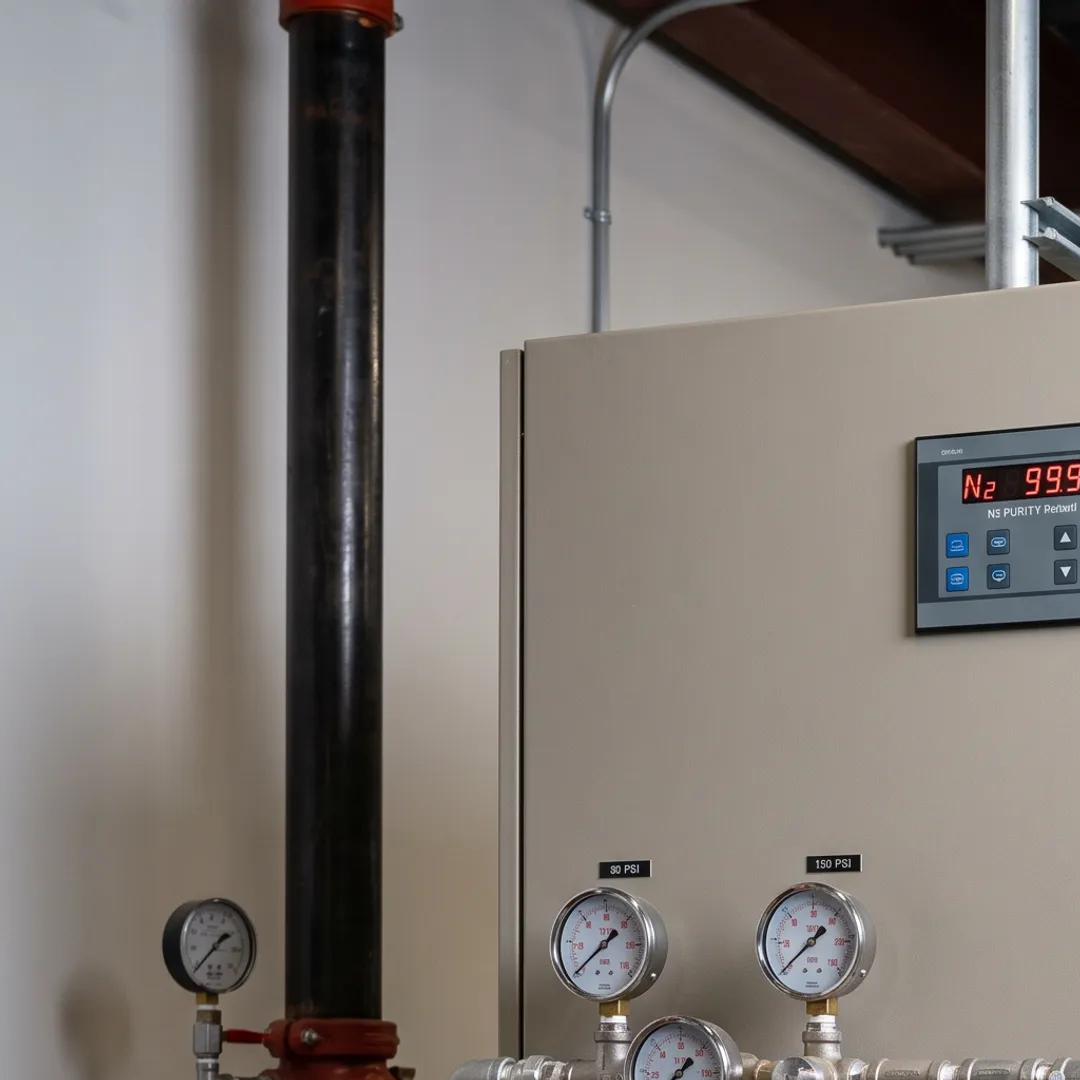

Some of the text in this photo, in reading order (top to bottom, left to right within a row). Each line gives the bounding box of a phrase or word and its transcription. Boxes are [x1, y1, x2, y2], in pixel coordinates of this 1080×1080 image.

[964, 473, 996, 499] N2
[1003, 505, 1042, 518] PURITY
[624, 864, 640, 874] PSI
[816, 858, 852, 869] 150 PSI
